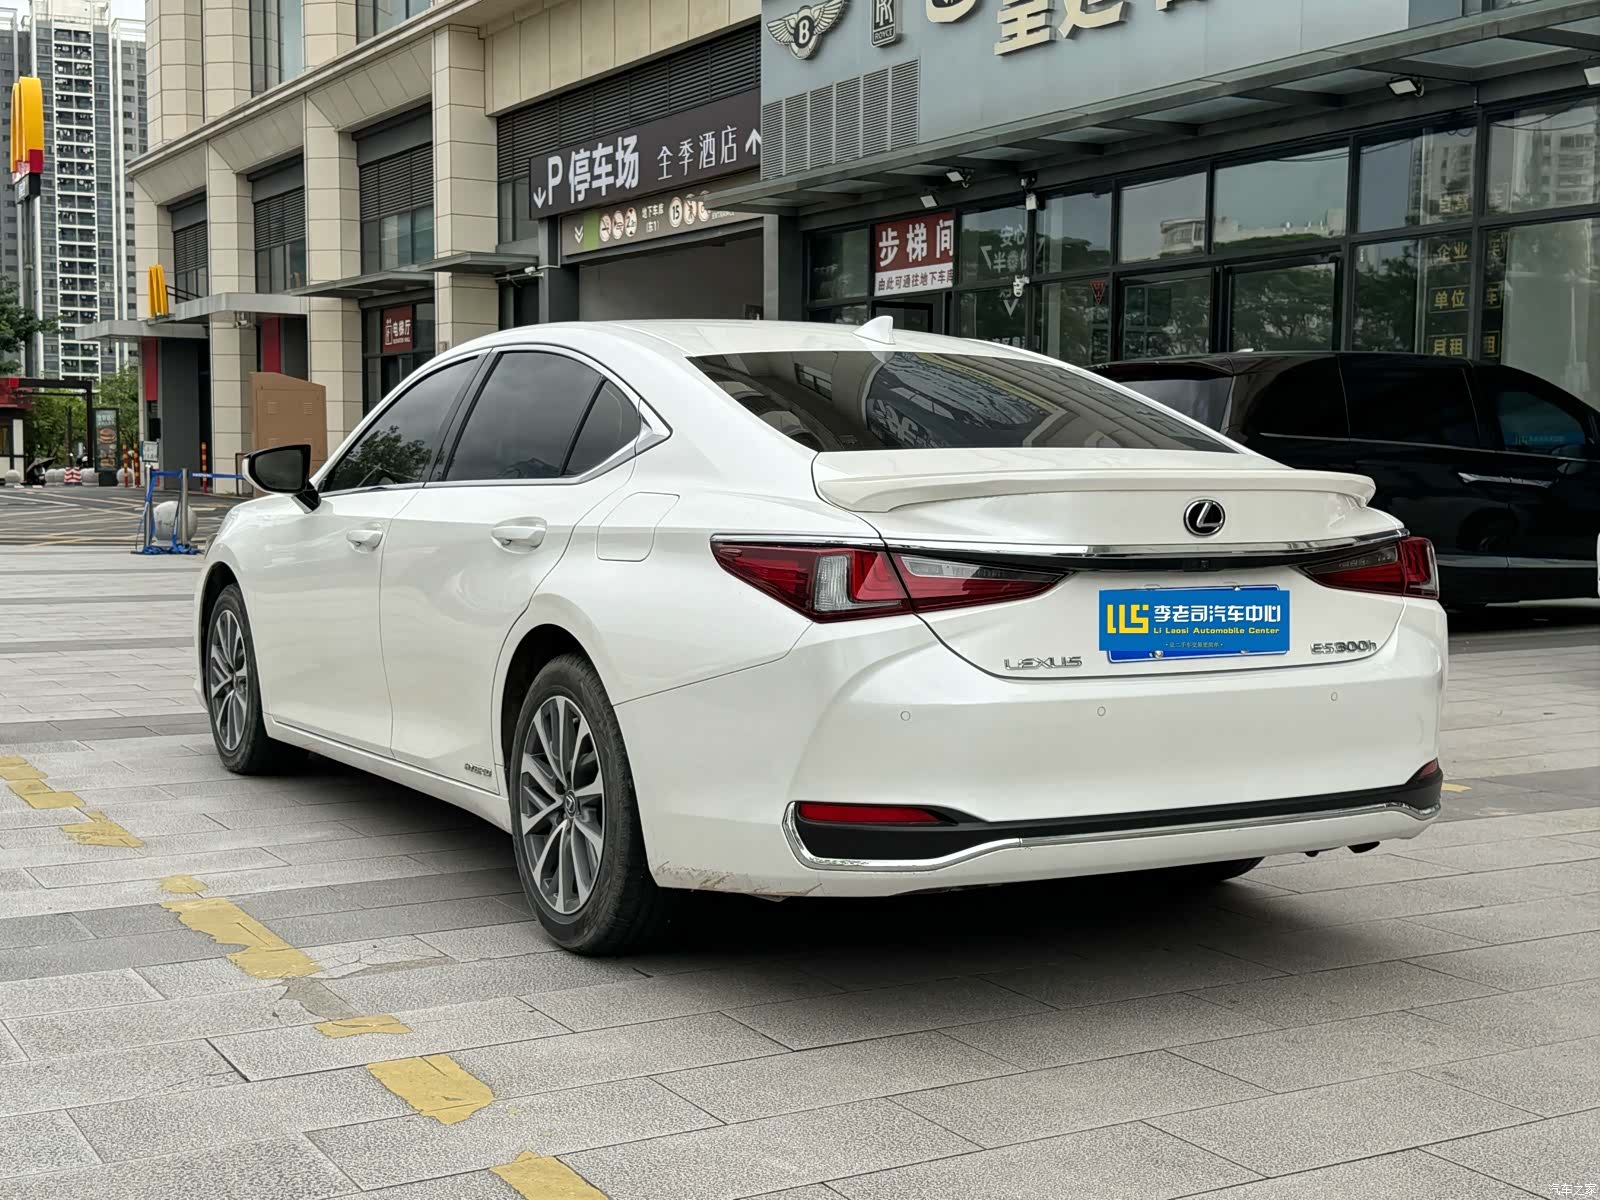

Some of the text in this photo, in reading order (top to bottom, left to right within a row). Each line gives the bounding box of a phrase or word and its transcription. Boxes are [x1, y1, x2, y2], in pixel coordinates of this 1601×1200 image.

[874, 28, 893, 41] ROYCE
[547, 134, 640, 206] P 停车场
[657, 124, 738, 181] 全季酒店
[878, 218, 954, 268] 步梯间
[1003, 655, 1083, 671] LEXUS
